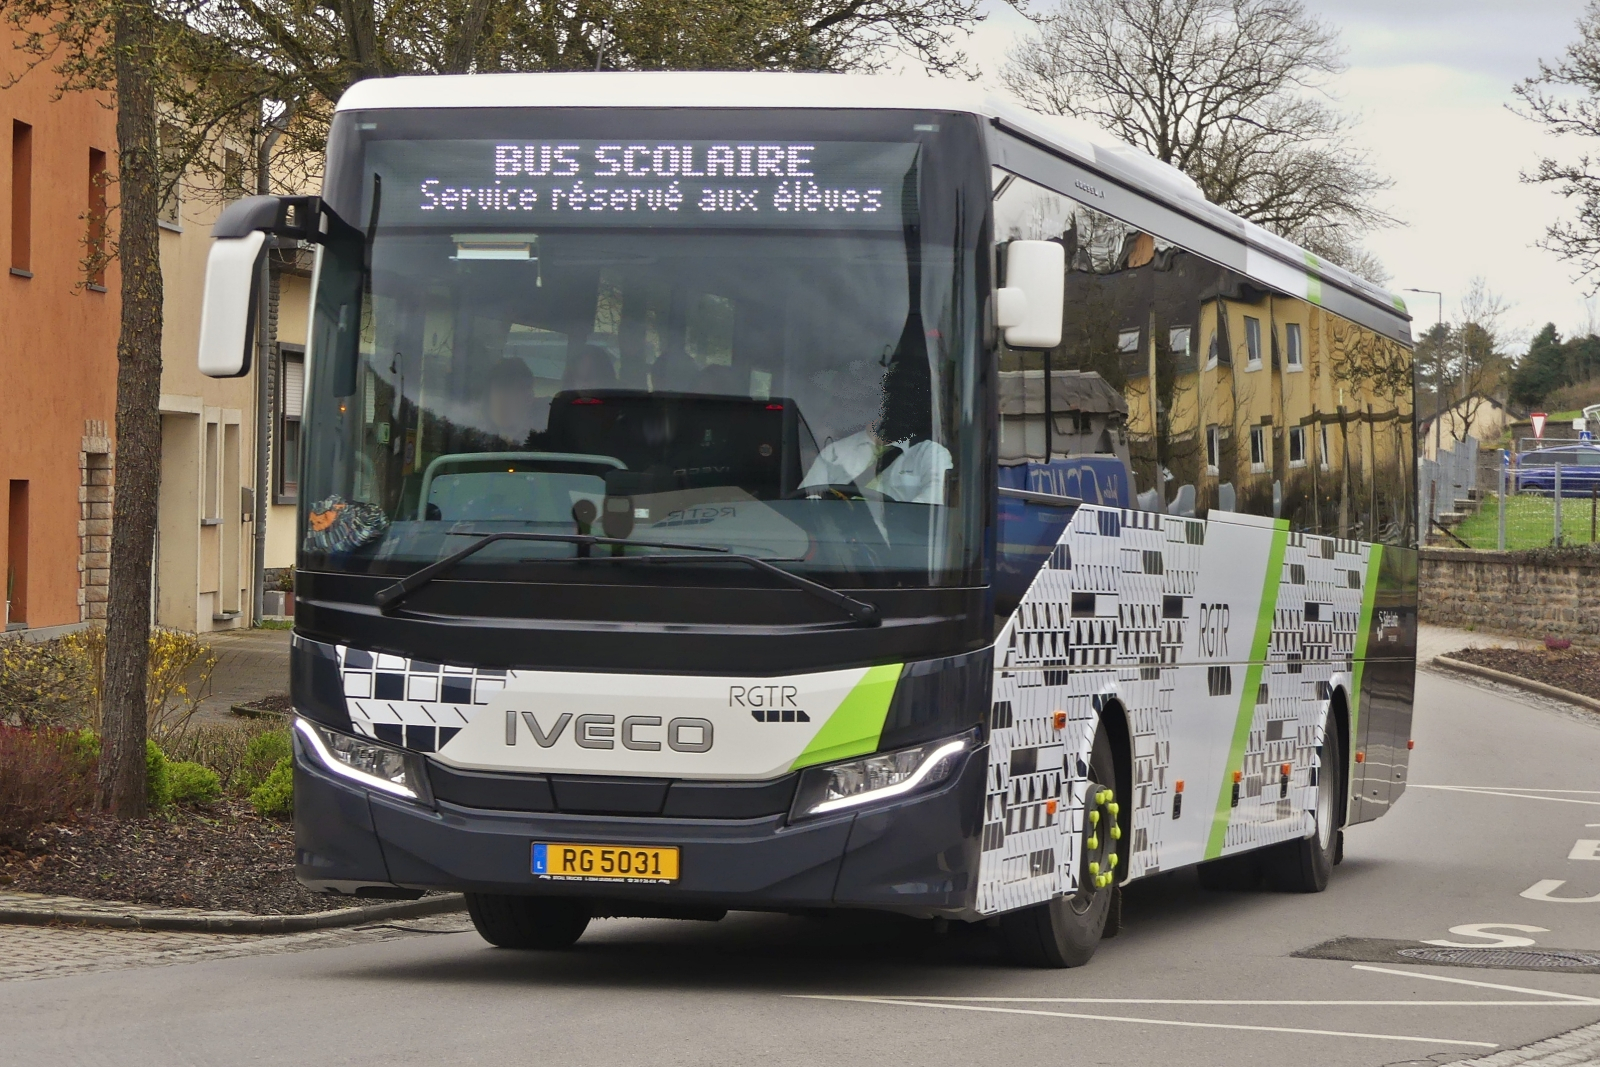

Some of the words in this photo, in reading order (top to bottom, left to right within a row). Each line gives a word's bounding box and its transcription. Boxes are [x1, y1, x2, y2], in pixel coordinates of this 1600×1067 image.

[494, 145, 581, 177] BUS
[594, 145, 816, 177] SCOLAIRE
[420, 180, 538, 211] Service
[551, 180, 684, 211] réservé
[698, 188, 759, 211] aux
[773, 180, 883, 212] élèves
[1198, 602, 1230, 658] RGTR
[729, 685, 798, 707] RGTR
[505, 710, 714, 753] IVECO
[537, 861, 543, 869] L
[563, 848, 594, 872] RG
[601, 850, 661, 875] 5031
